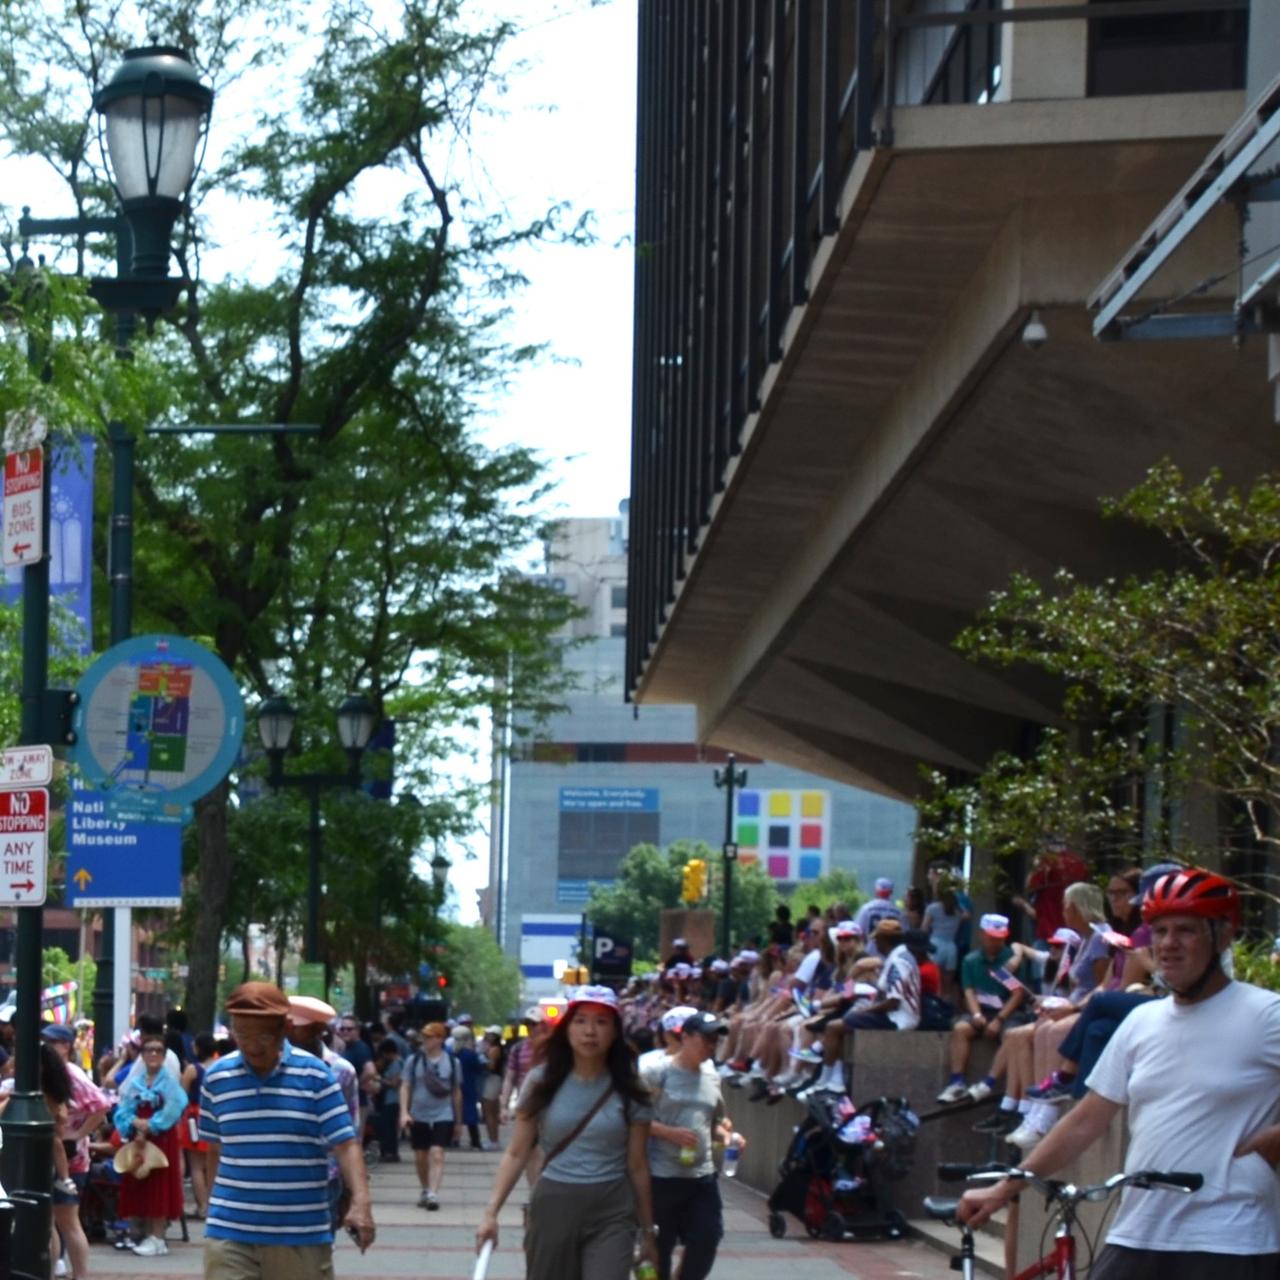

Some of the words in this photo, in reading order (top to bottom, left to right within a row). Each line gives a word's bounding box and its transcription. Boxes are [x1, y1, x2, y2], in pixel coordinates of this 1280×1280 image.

[16, 452, 31, 474] NO
[11, 501, 32, 518] BUS
[7, 517, 35, 536] ZONE
[23, 753, 47, 765] AWAY
[9, 768, 33, 780] ZONE
[10, 792, 31, 815] NO
[72, 801, 104, 813] Nati
[72, 833, 137, 845] Museum
[3, 842, 34, 856] ANY
[3, 861, 34, 874] TIME
